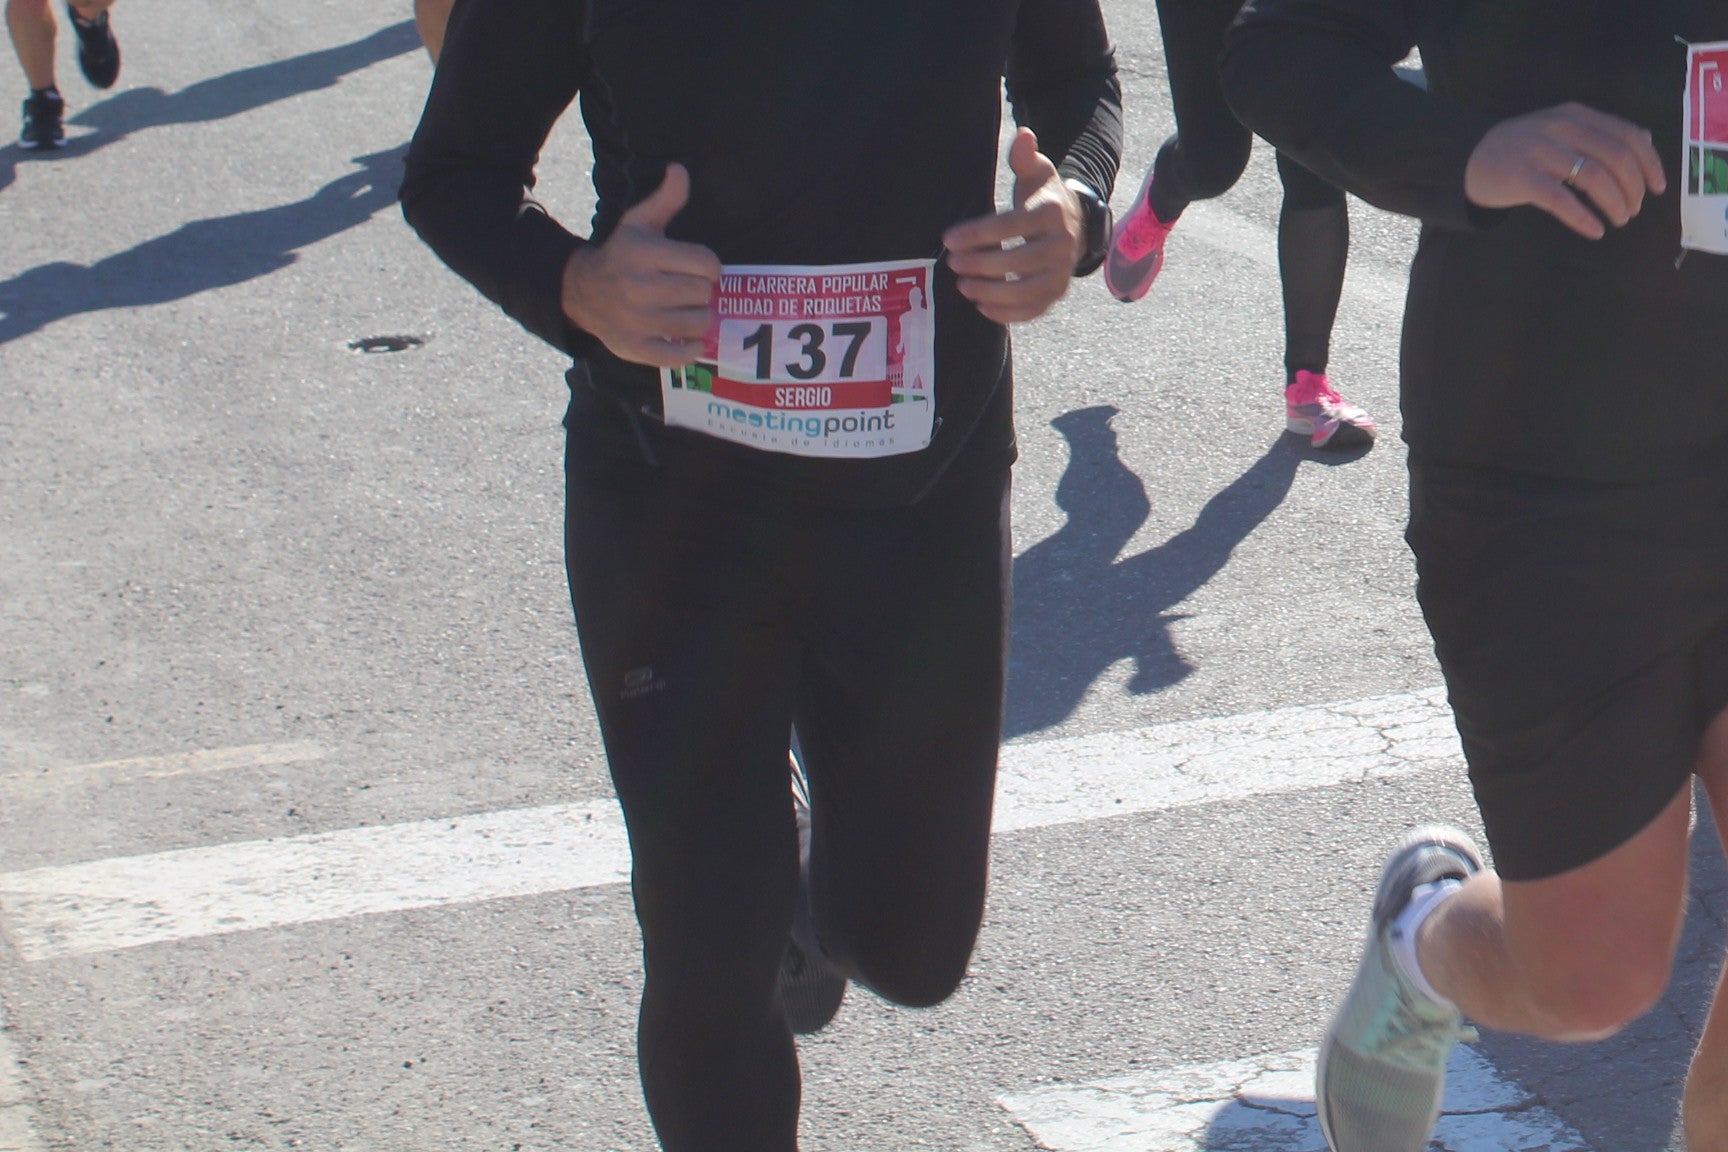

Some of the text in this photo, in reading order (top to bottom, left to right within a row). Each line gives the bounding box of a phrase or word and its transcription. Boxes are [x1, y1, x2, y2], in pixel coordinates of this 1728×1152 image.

[720, 274, 888, 294] VIII CARRERA POPULAR
[718, 295, 882, 316] CIUDAD DE ROQUETAS
[743, 321, 871, 380] 137
[775, 387, 832, 407] SERGIO
